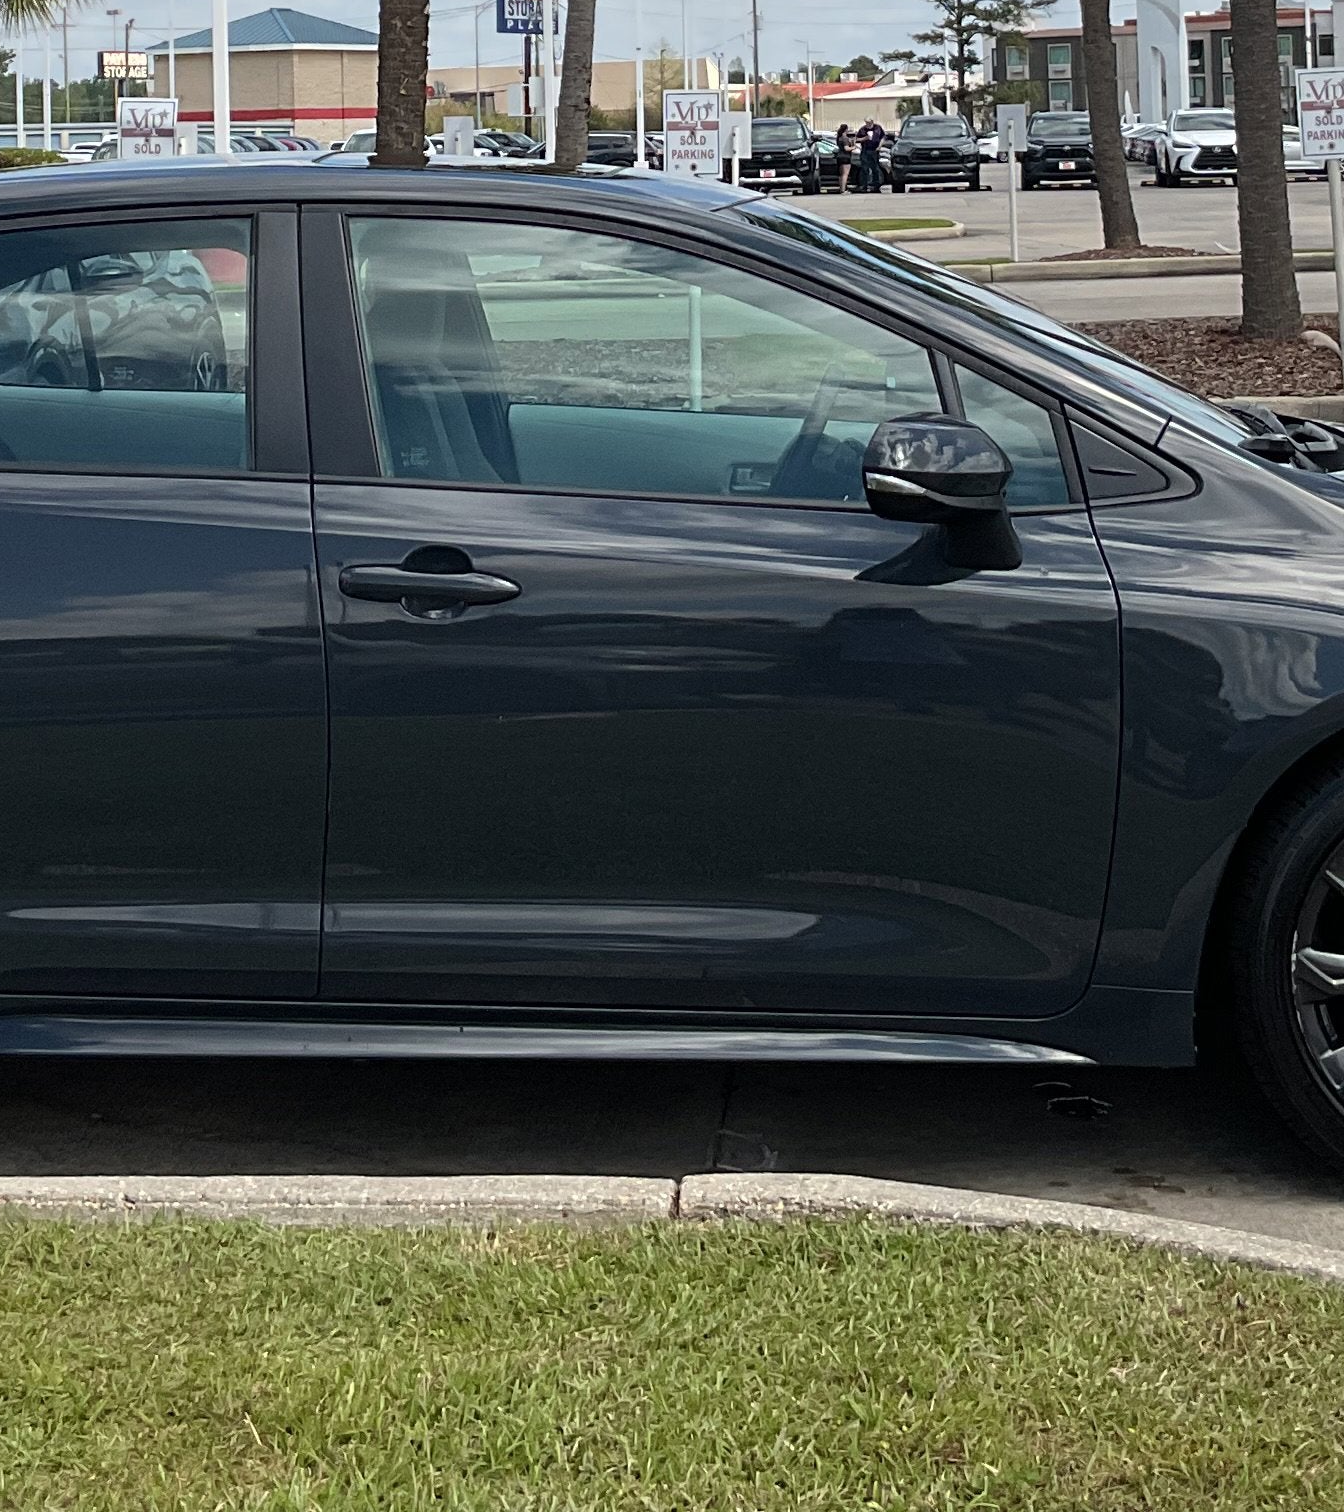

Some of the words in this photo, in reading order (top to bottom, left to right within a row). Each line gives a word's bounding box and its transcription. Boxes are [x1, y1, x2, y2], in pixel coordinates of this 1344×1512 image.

[1314, 114, 1343, 127] SOLD
[679, 135, 707, 146] SOLD
[134, 143, 161, 155] SOLD
[671, 149, 715, 160] PARKING
